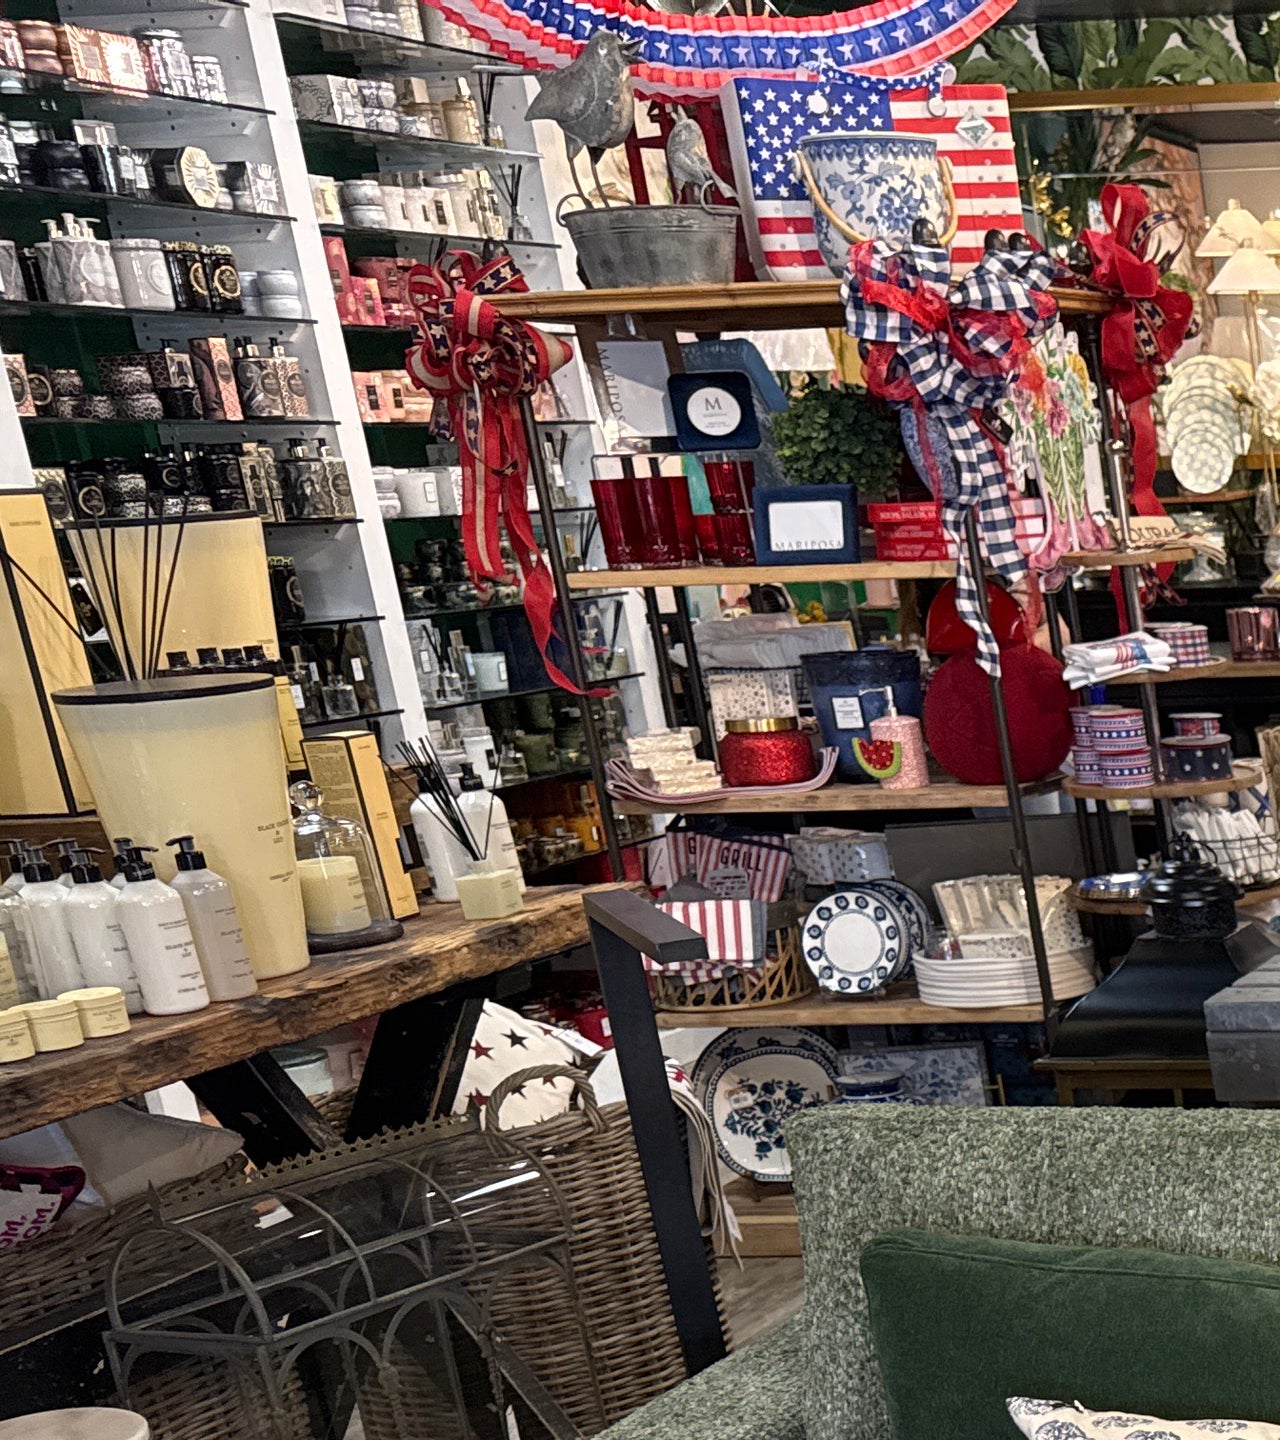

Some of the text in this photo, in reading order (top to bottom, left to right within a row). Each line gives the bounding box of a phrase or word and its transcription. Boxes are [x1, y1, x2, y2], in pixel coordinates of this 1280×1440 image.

[599, 347, 629, 432] MARIPOS
[704, 397, 722, 411] M
[775, 540, 842, 550] MARIPOSA
[720, 846, 762, 872] GRILL
